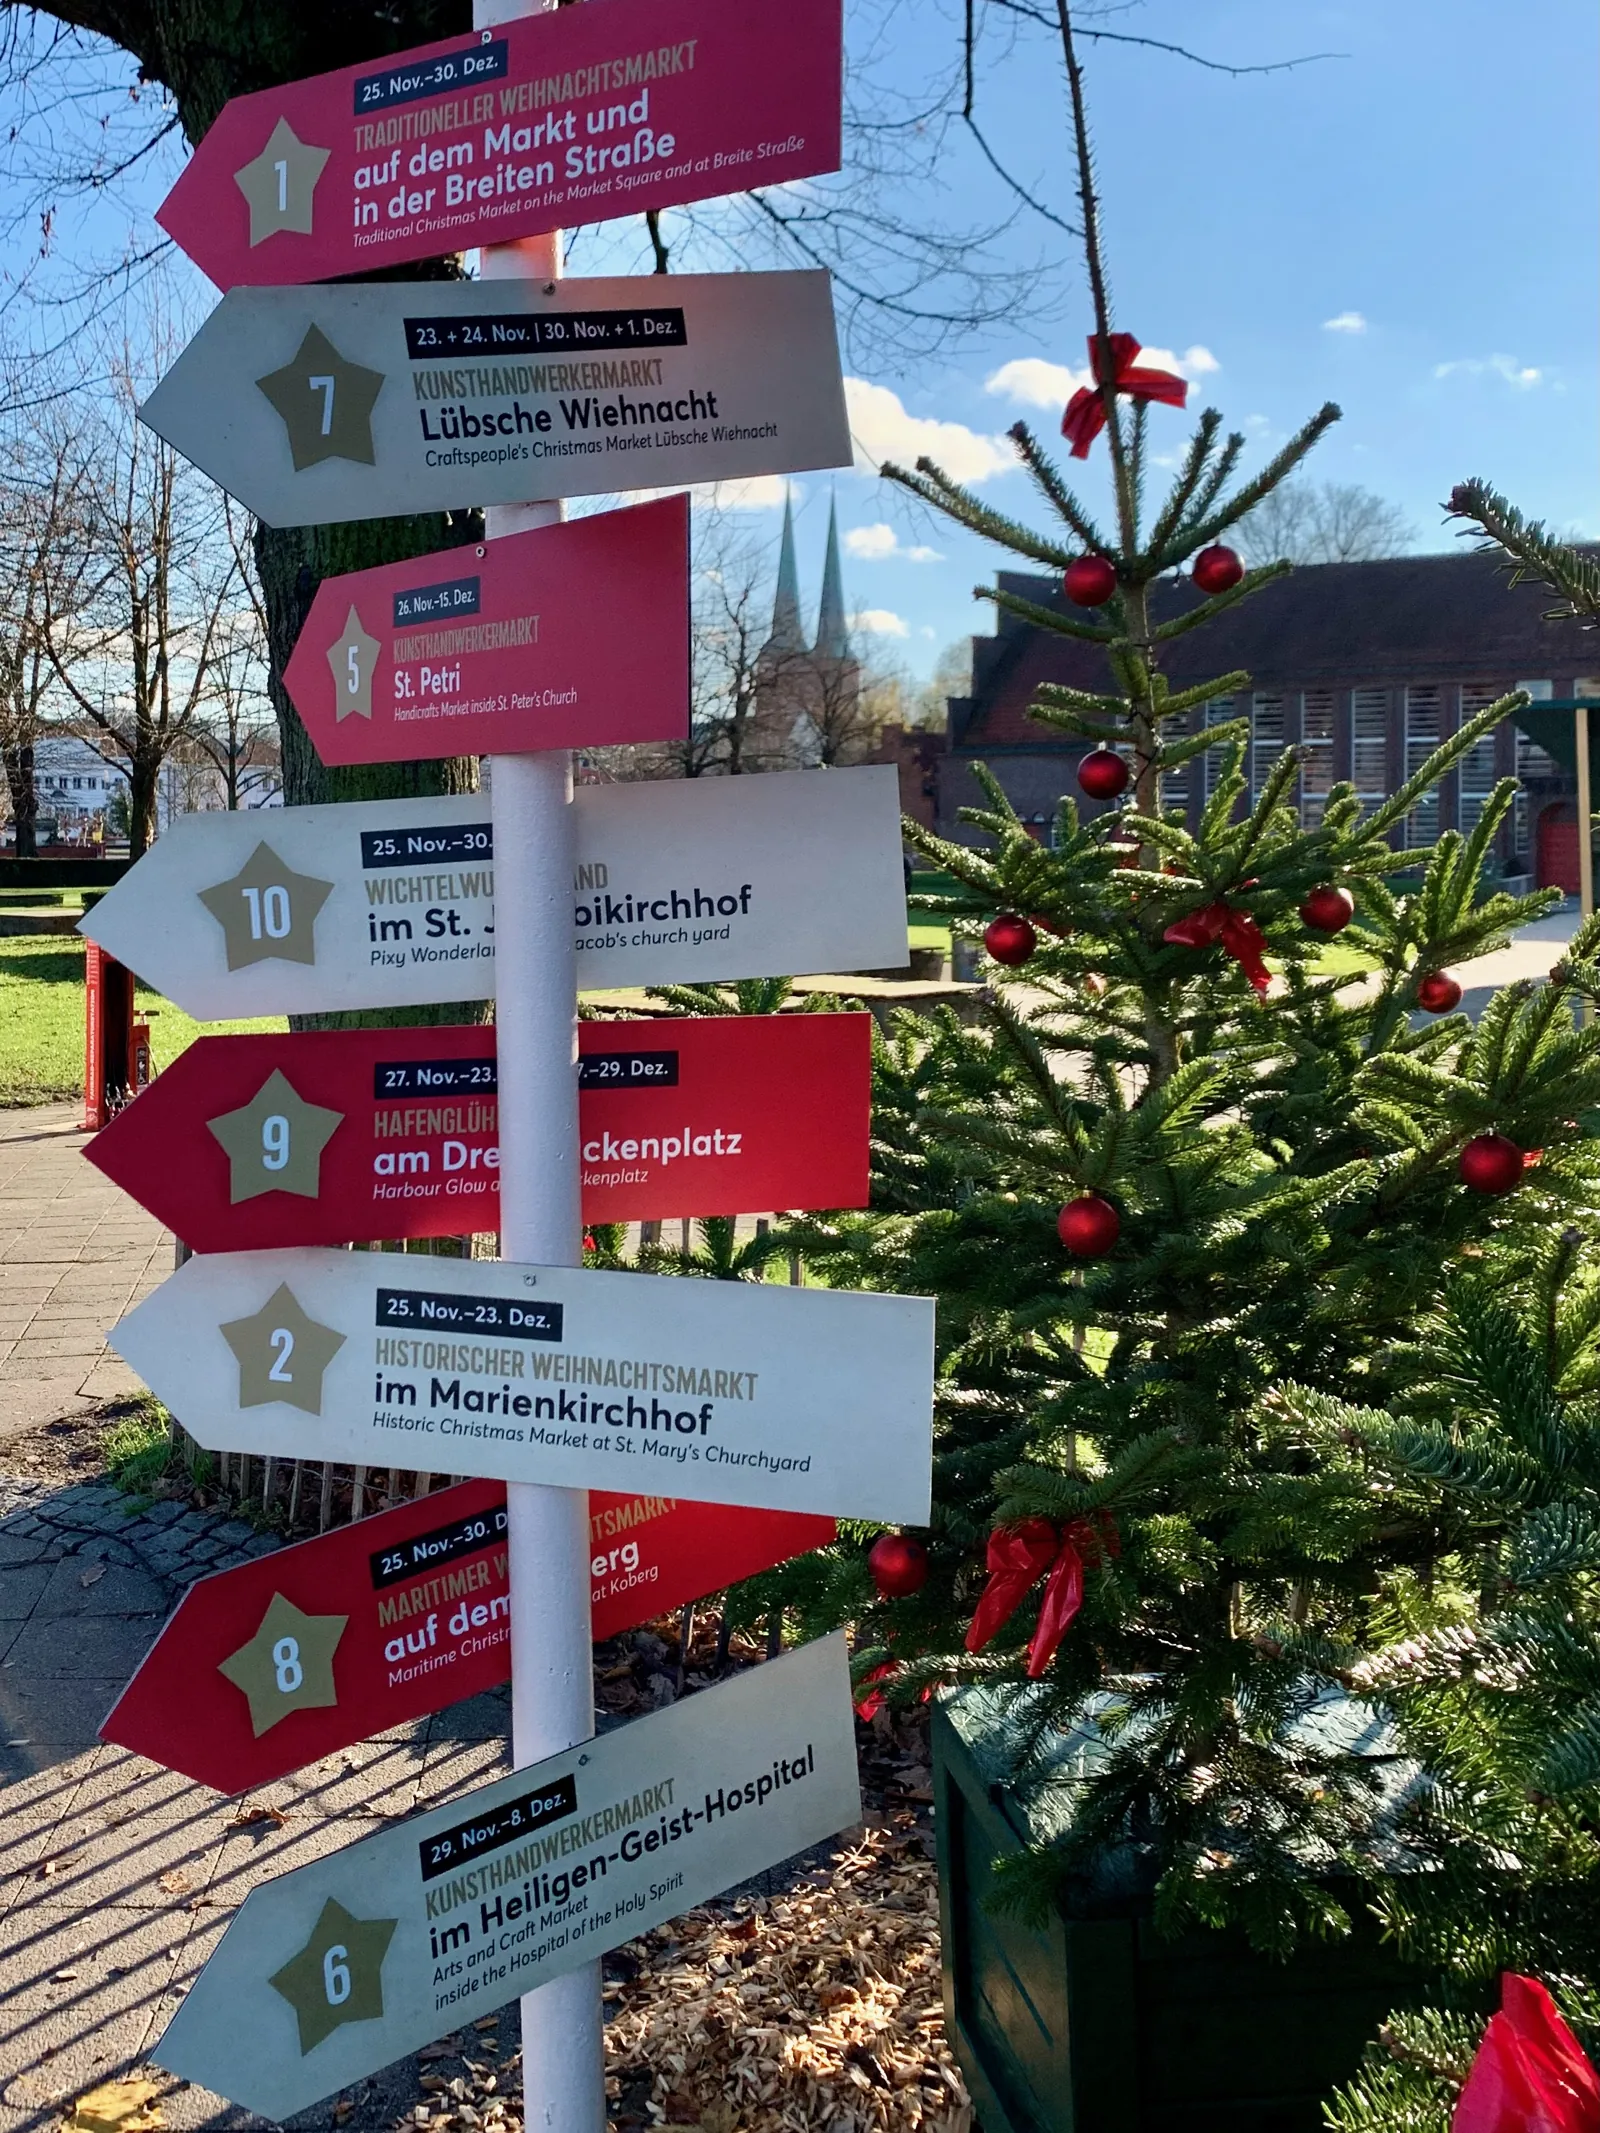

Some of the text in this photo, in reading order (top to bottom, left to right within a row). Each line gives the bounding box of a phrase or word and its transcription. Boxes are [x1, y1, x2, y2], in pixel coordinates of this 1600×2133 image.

[353, 39, 698, 154] TRADITIONELLER WEIHNACHTSMARKT
[362, 84, 385, 103] 25.
[463, 54, 499, 76] Dez.
[353, 87, 649, 190] auf dem Markt und
[275, 160, 288, 211] 1
[353, 127, 676, 228] in der Breiten Straße
[353, 135, 805, 248] Traditional Christmas Market on the Market Square and at Breite Straße
[416, 327, 442, 346] 23.
[447, 331, 457, 343] +
[462, 326, 488, 344] 24.
[492, 324, 530, 342] Nov.
[544, 322, 570, 340] 30.
[573, 321, 610, 339] Nov.
[614, 324, 624, 335] +
[627, 320, 640, 336] 1.
[643, 318, 677, 335] Dez.
[309, 375, 337, 436] 7
[412, 358, 663, 401] KUNSTHANDWERKERMARKT
[420, 389, 719, 441] Lübsche Wiehnacht
[532, 440, 603, 458] Christmas
[606, 432, 652, 452] Market
[711, 422, 779, 442] Wiehnacht
[398, 600, 412, 616] 26.
[454, 588, 475, 606] Dez.
[393, 614, 540, 665] KUNSTHANDWERKERMARKT
[347, 645, 360, 694] 5
[394, 662, 461, 700] St. Petri
[394, 700, 440, 721] Handicrafts
[440, 700, 470, 717] Market
[471, 695, 496, 713] inside
[497, 694, 508, 711] St.
[542, 687, 578, 706] Church
[372, 839, 401, 856] 25.
[242, 885, 292, 939] 10
[368, 912, 413, 942] im
[425, 907, 472, 938] St.
[370, 950, 406, 968] Pixy
[631, 927, 688, 946] church
[693, 923, 730, 945] yard
[385, 1070, 410, 1088] 27.
[631, 1060, 669, 1076] Dez.
[262, 1115, 291, 1170] 9
[373, 1150, 430, 1176] am
[373, 1183, 442, 1200] Harbour
[445, 1178, 487, 1195] Glow
[580, 1168, 649, 1188] kenplatz
[387, 1298, 414, 1317] 25.
[509, 1308, 552, 1329] Dez.
[269, 1328, 295, 1382] 2
[375, 1337, 759, 1401] HISTORISCHER WEIHNACHTSMARKT
[375, 1372, 714, 1436] im Marienkirchhof
[372, 1411, 435, 1433] Historic
[440, 1418, 524, 1442] Christmas
[529, 1427, 589, 1449] Market
[592, 1435, 611, 1451] at
[615, 1436, 636, 1454] St.
[705, 1445, 812, 1473] Churchyard
[380, 1553, 408, 1575] 25.
[377, 1560, 491, 1629] MARITIMER
[384, 1613, 438, 1662] auf
[388, 1650, 457, 1688] Maritime
[591, 1584, 607, 1603] at
[610, 1565, 658, 1596] Koberg
[272, 1637, 303, 1694] 8
[425, 1777, 675, 1921] KUNSTHANDWERKERMARKT
[430, 1744, 815, 1960] im Heiligen-Geist-Hospital
[431, 1842, 457, 1864] 29.
[530, 1792, 567, 1818] Dez.
[432, 1895, 589, 1986] Arts and Craft Market
[435, 1871, 684, 2012] inside the Hospital of the Holy Spirit
[323, 1945, 352, 2005] 6
